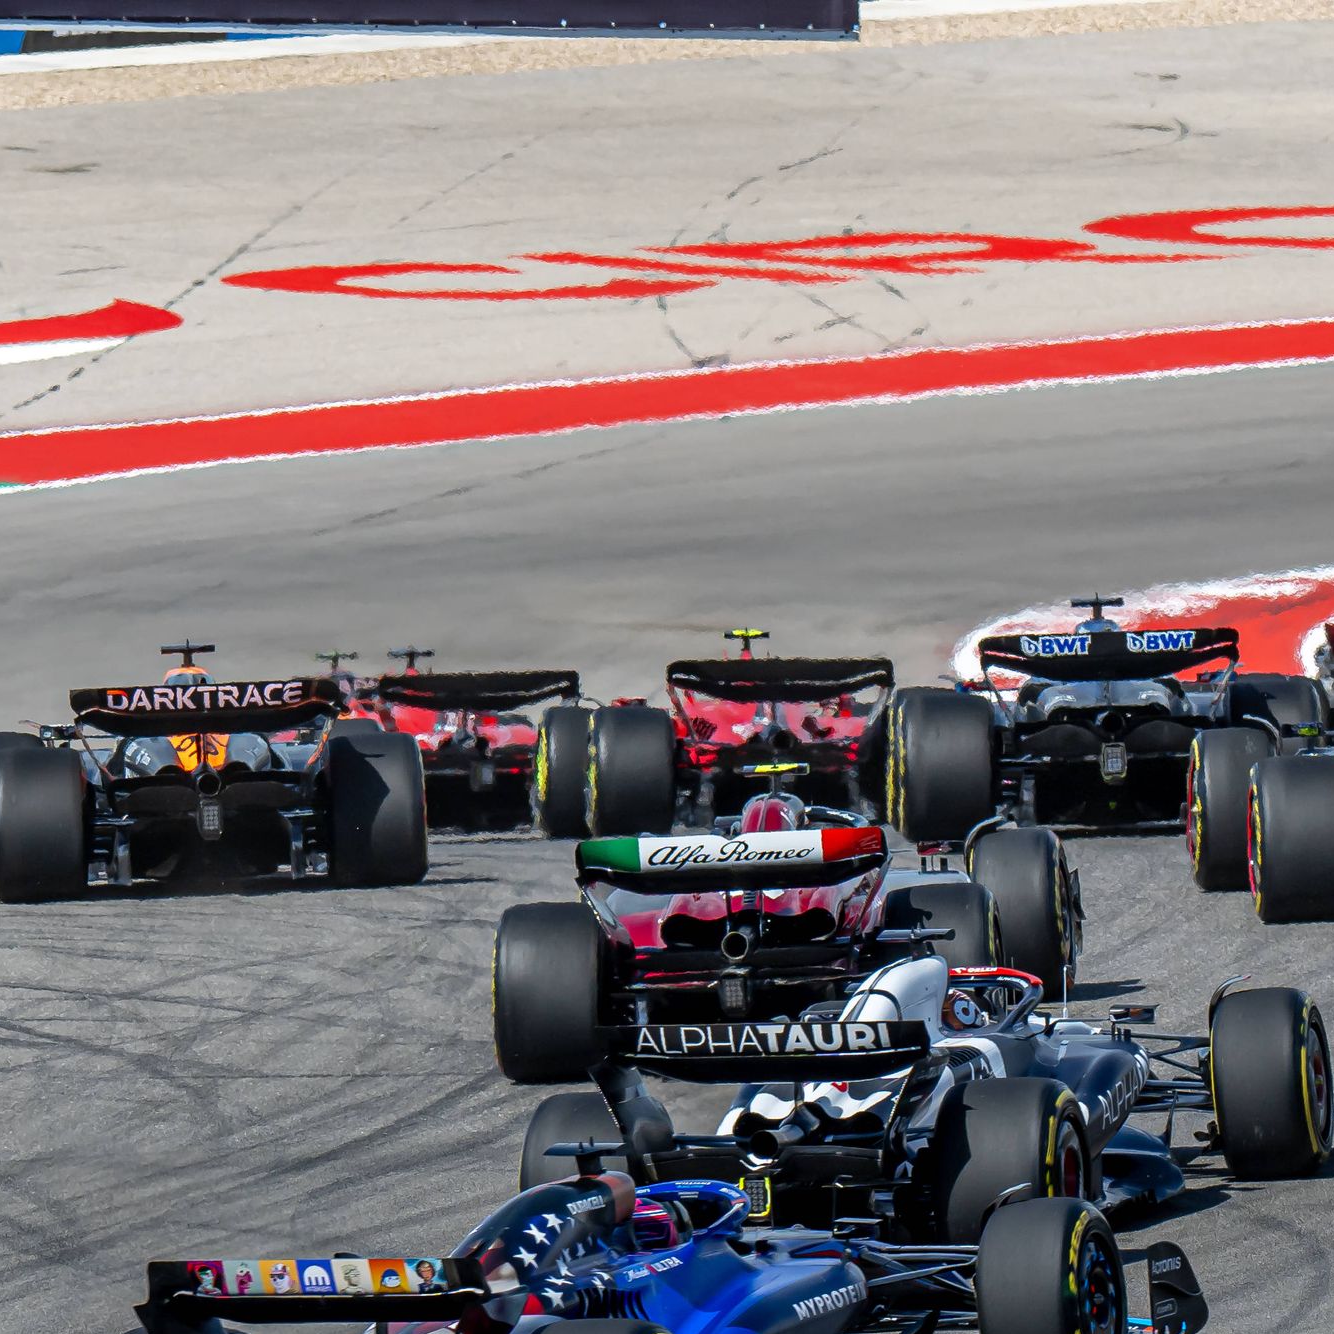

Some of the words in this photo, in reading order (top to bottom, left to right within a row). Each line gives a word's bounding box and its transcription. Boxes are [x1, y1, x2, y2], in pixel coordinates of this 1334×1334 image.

[1039, 635, 1092, 656] BWT
[1144, 631, 1195, 650] BWT
[107, 681, 303, 711] DARKTRACE
[648, 844, 716, 871] Alfa
[717, 840, 815, 862] Romeo
[637, 1023, 891, 1054] ALPHATAURI
